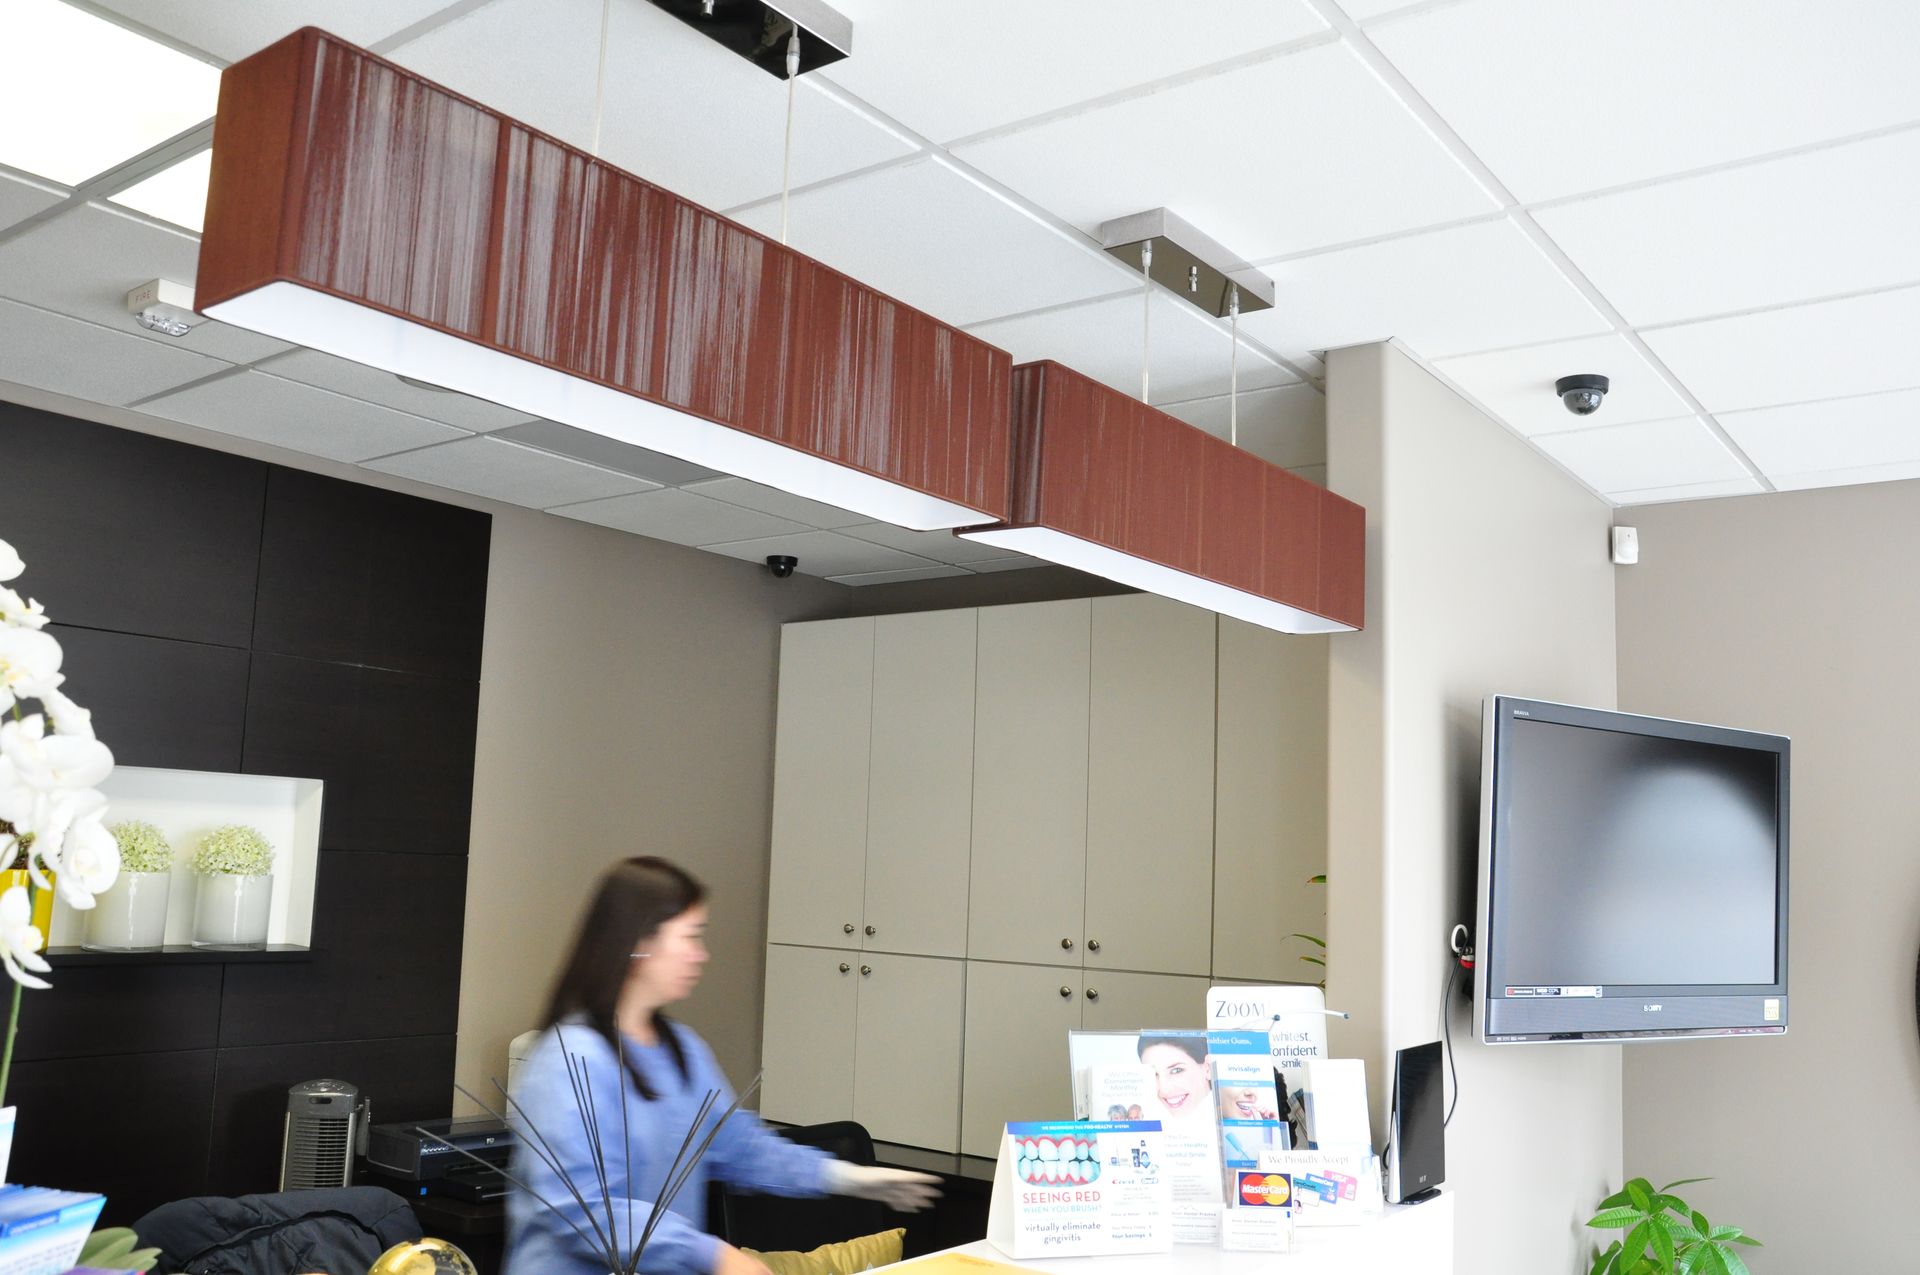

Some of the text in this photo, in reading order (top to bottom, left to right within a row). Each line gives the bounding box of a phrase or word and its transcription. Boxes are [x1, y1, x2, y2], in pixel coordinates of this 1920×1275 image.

[1643, 1004, 1663, 1012] SONY
[1272, 1045, 1317, 1056] onfident
[1268, 1155, 1349, 1165] We Proudly Accept
[1241, 1184, 1288, 1195] MasterCard
[1023, 1191, 1101, 1204] SEEING RED
[1023, 1204, 1102, 1214] WHEN YOU BRUSH?
[1025, 1221, 1101, 1233] virtually eliminate
[1044, 1234, 1081, 1244] gingivitis
